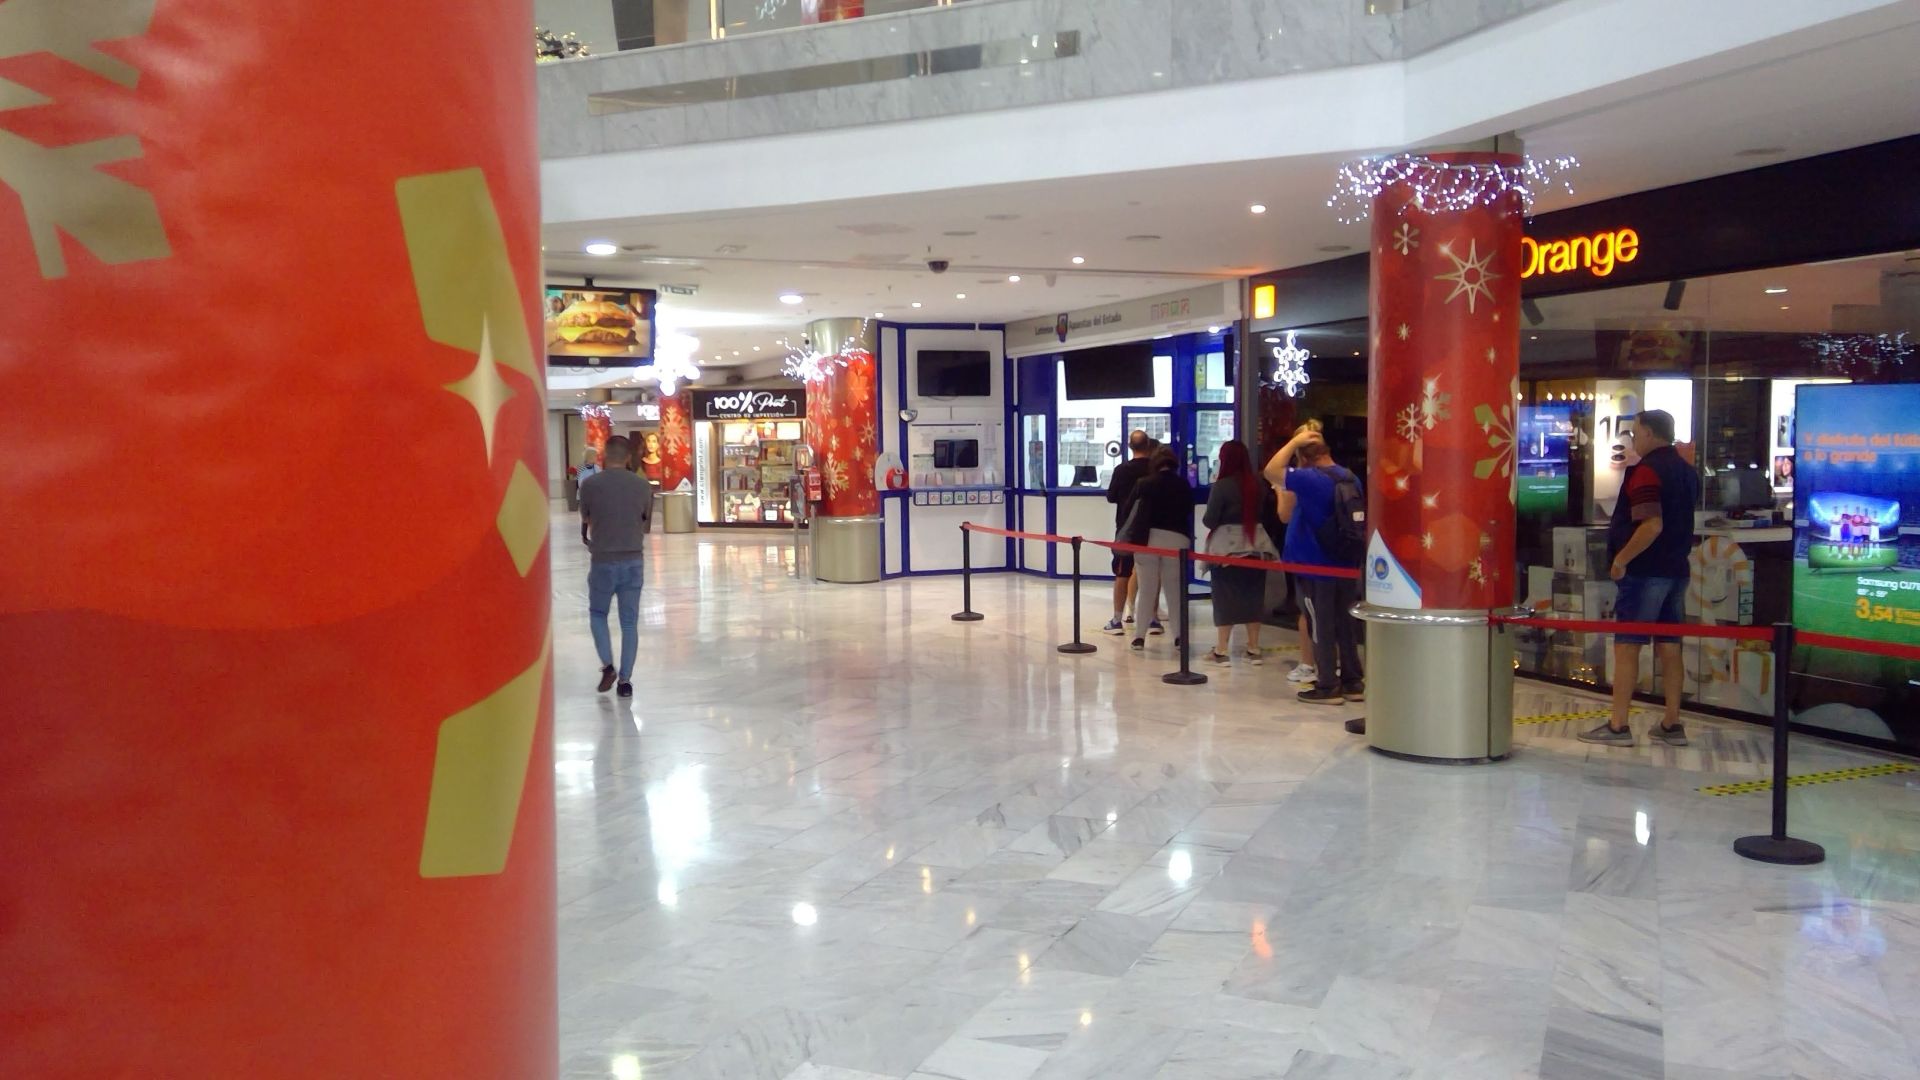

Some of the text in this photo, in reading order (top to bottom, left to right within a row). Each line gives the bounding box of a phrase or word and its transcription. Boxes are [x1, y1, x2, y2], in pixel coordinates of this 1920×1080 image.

[1520, 228, 1639, 279] Orange
[714, 391, 753, 413] 100%
[1857, 576, 1898, 591] Samsung
[1856, 598, 1892, 622] 3,54
